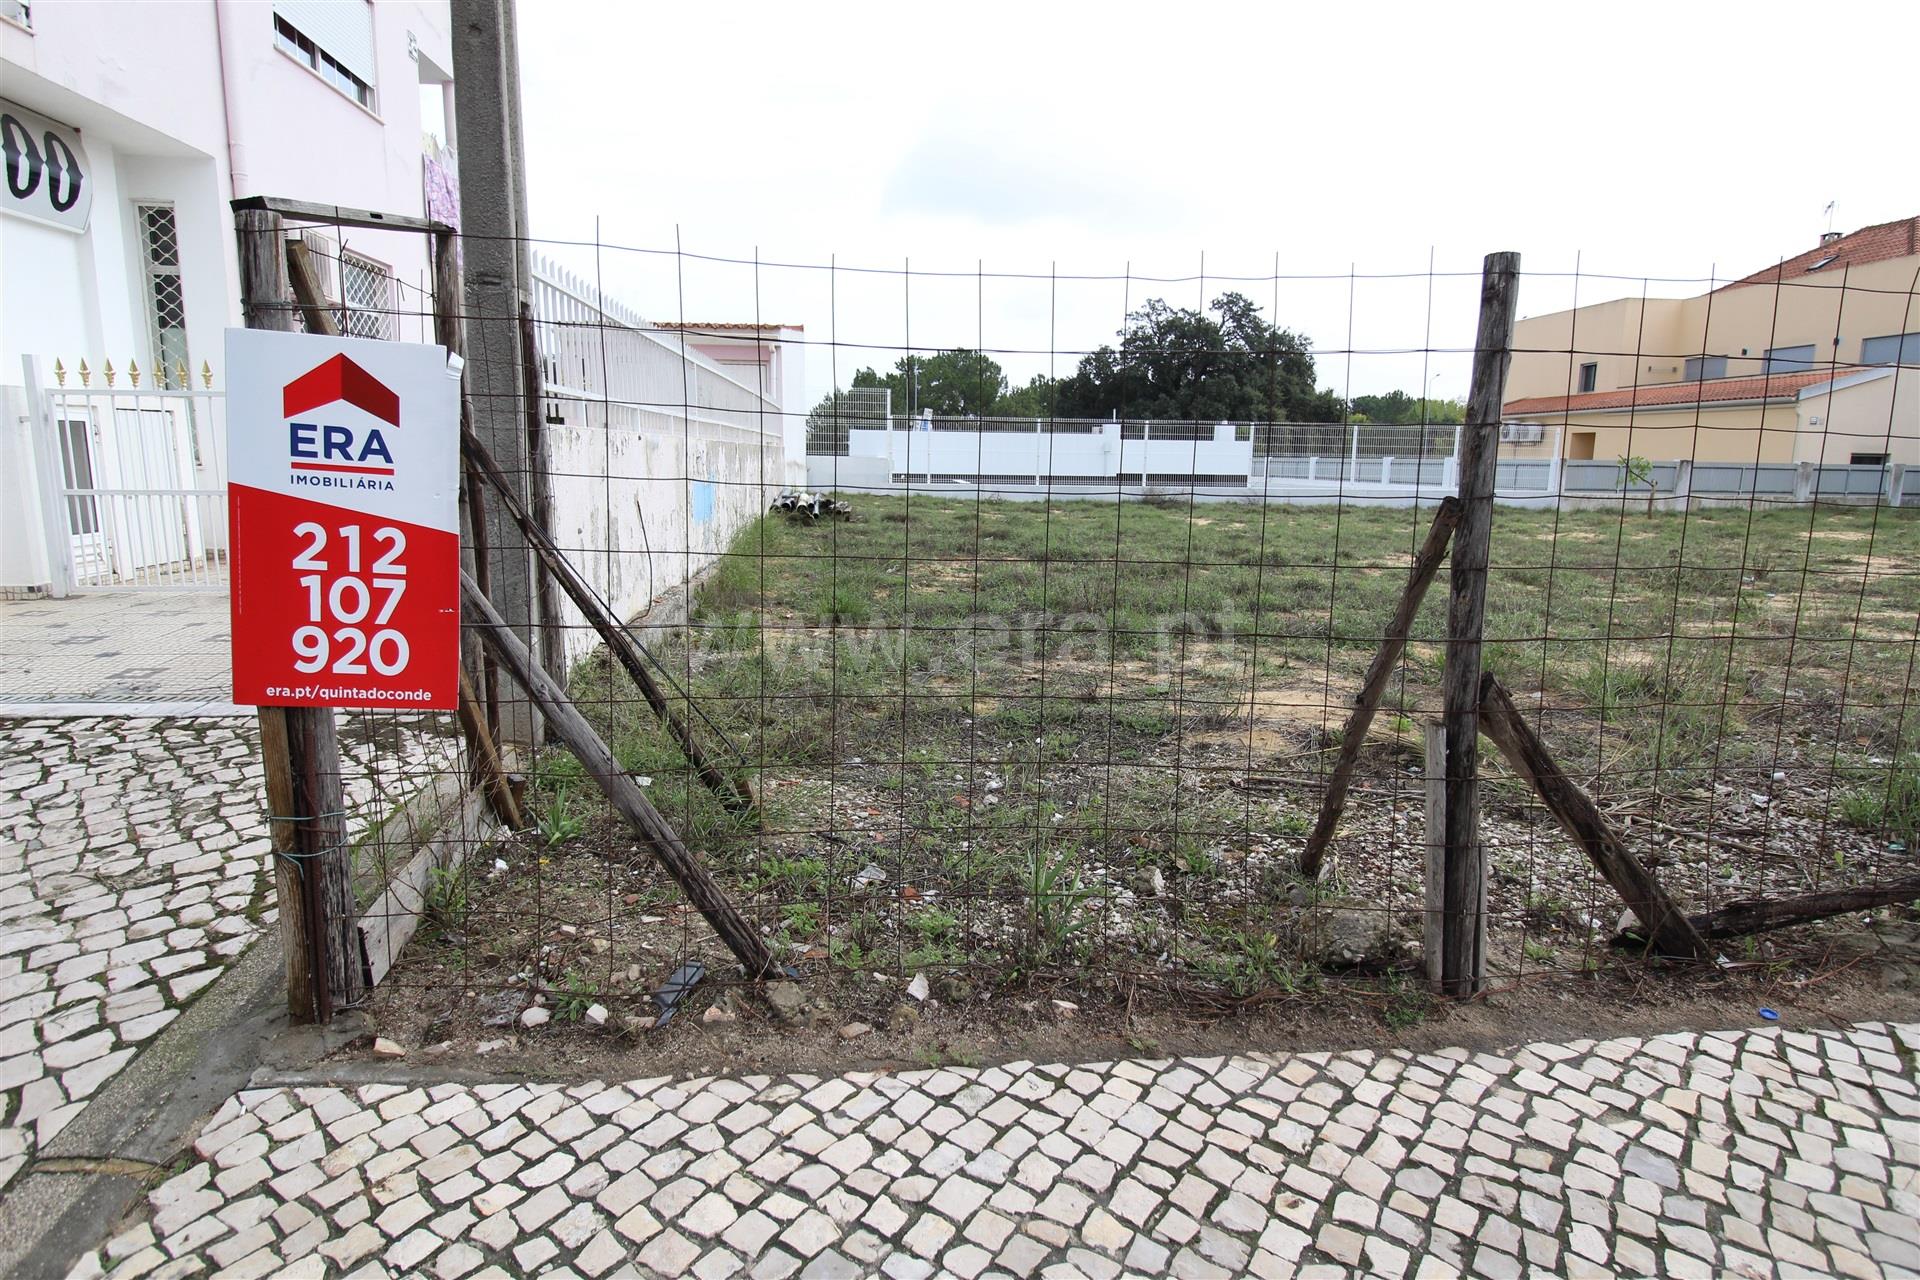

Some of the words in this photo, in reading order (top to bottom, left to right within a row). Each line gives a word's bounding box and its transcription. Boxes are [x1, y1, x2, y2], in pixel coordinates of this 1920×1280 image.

[290, 422, 394, 464] ERA
[290, 474, 395, 491] IMOBILIÁRIA
[292, 521, 407, 575] 212
[299, 574, 407, 625] 107
[292, 625, 410, 677] 920
[266, 684, 432, 703] era.pt/quintadoconde
